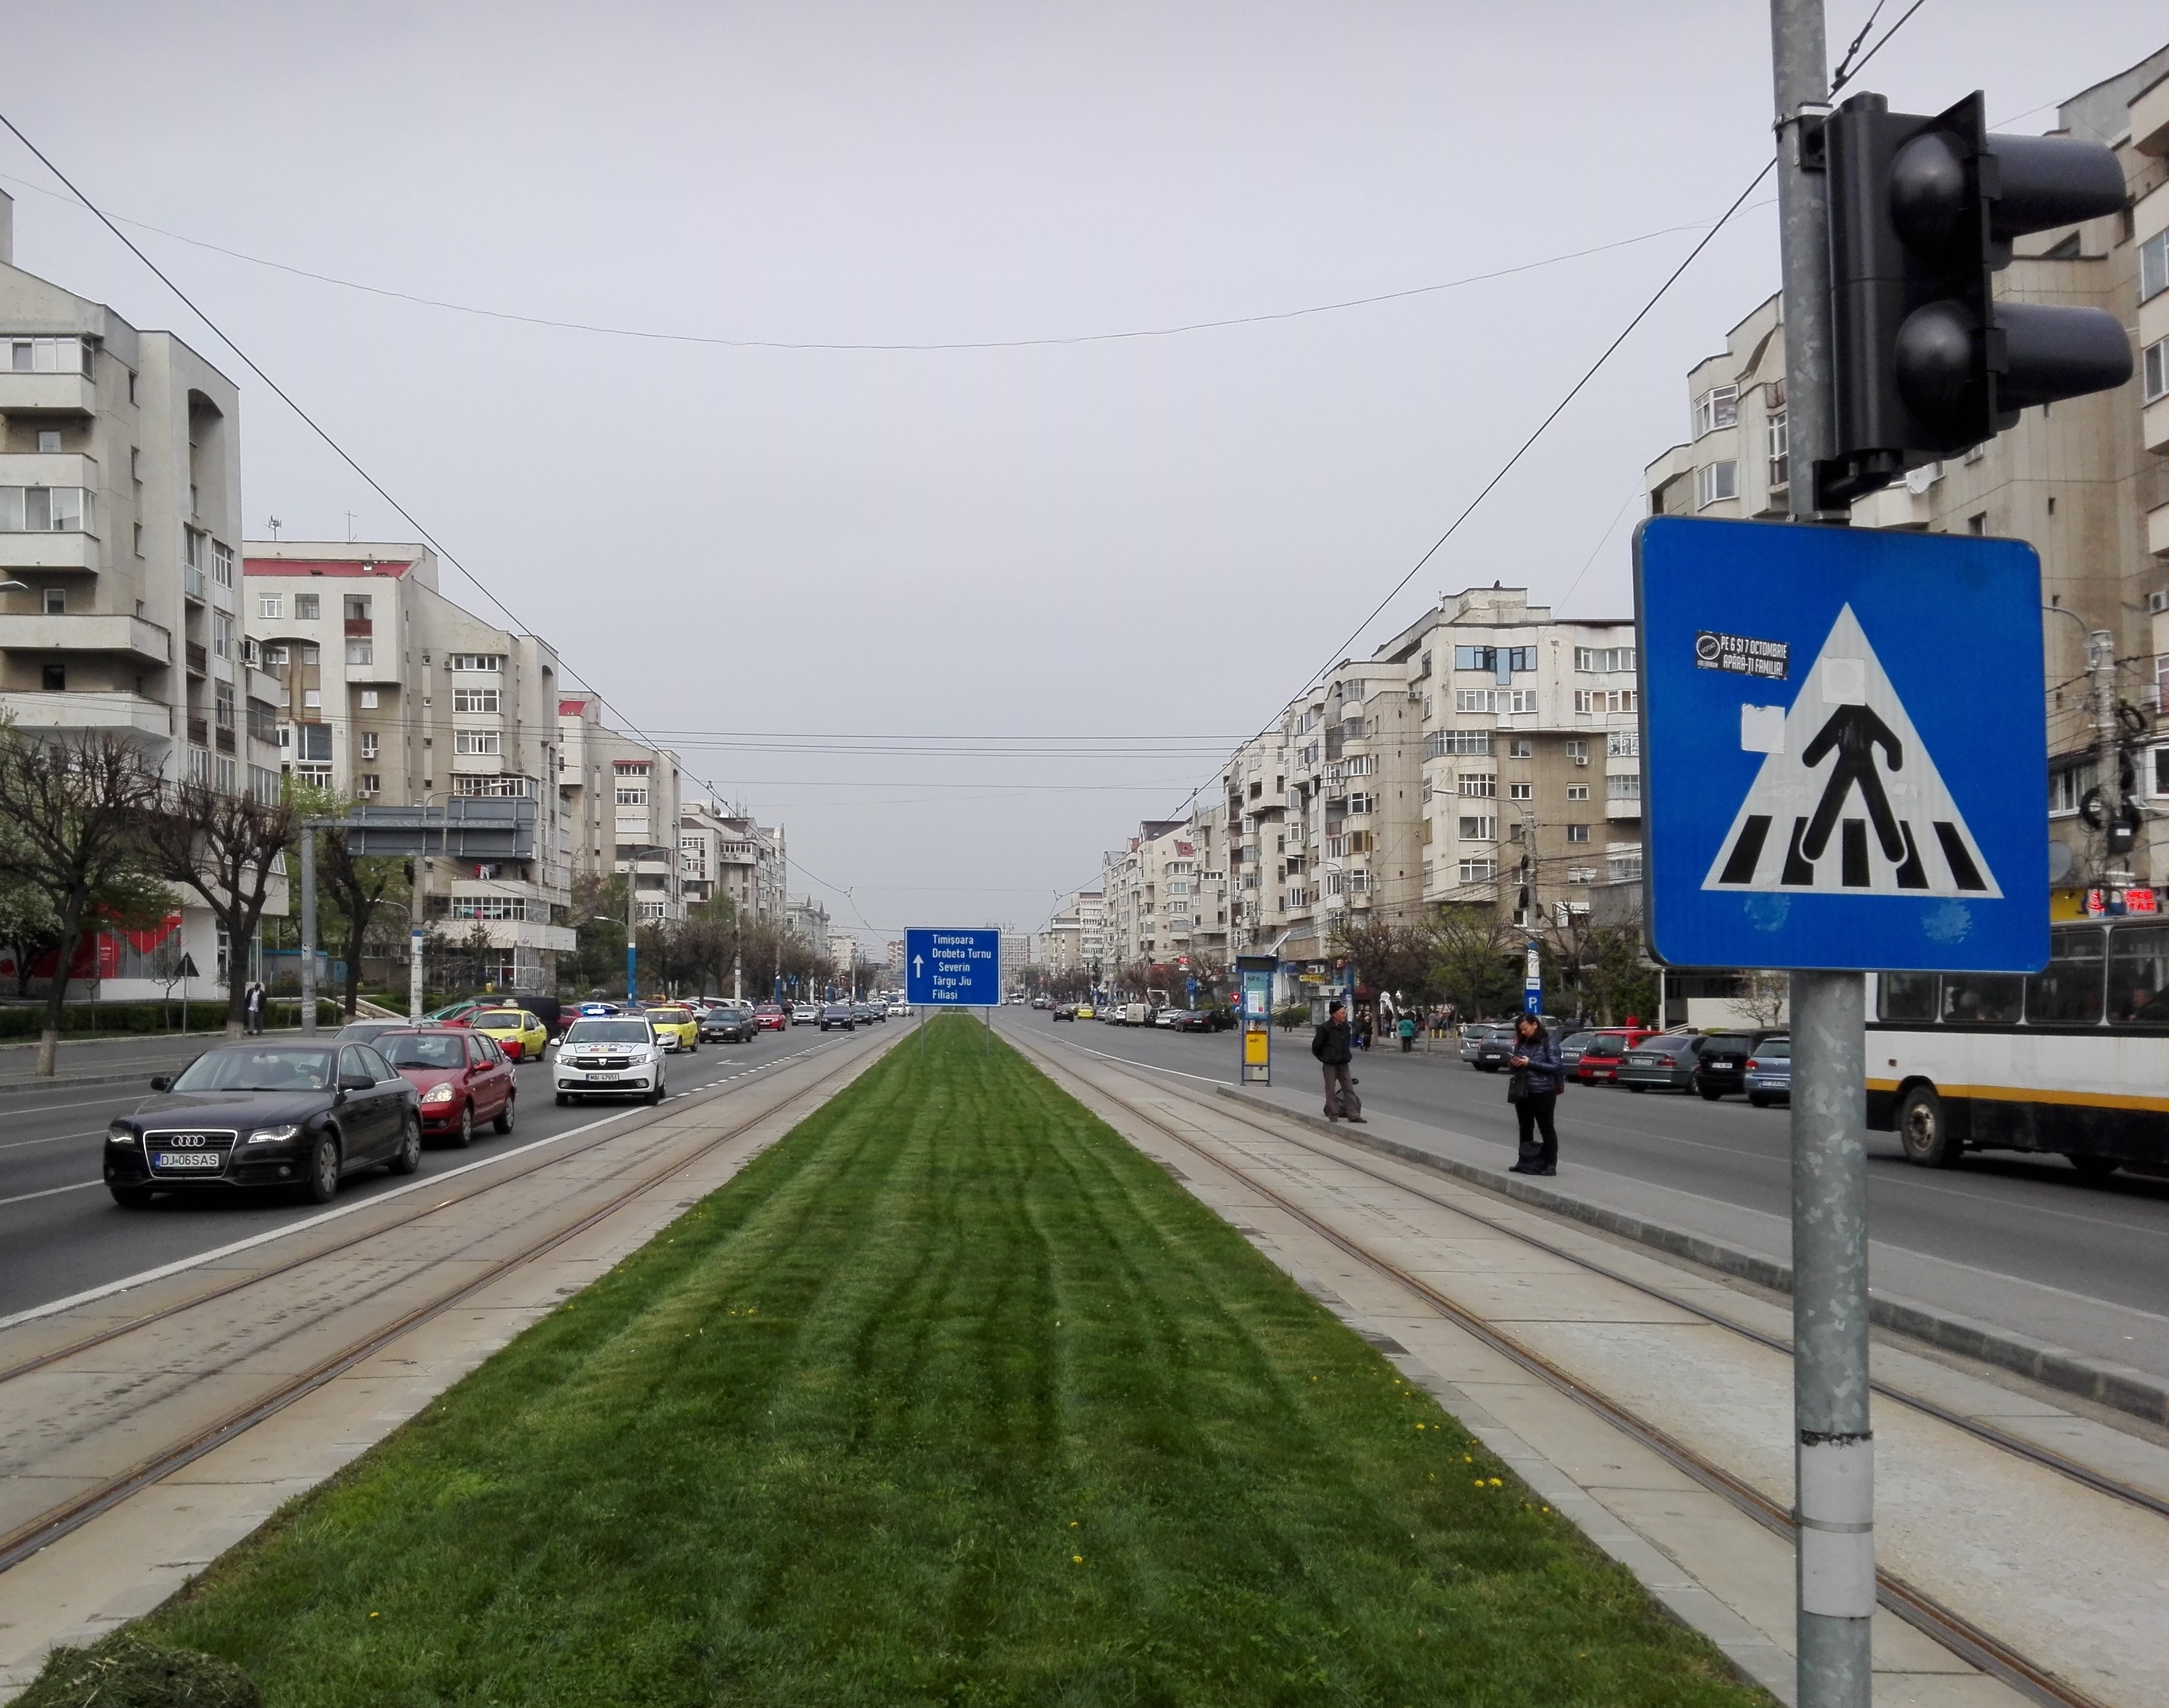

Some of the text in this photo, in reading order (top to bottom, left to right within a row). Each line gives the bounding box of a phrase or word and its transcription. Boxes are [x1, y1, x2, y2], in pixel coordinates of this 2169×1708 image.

[1700, 642, 1716, 653] VOTAT
[1721, 636, 1729, 650] PE
[1731, 638, 1735, 651] 6
[1745, 639, 1749, 653] 7
[1750, 640, 1787, 659] OCTOMBRIE
[1755, 658, 1783, 676] FAMILIA!
[932, 934, 974, 946] Timișoara
[932, 948, 991, 959] Drobeta Turnu
[938, 962, 970, 972] Severin
[932, 975, 972, 988] Târgu Jiu
[932, 989, 958, 1000] Filiași
[1529, 997, 1537, 1008] P
